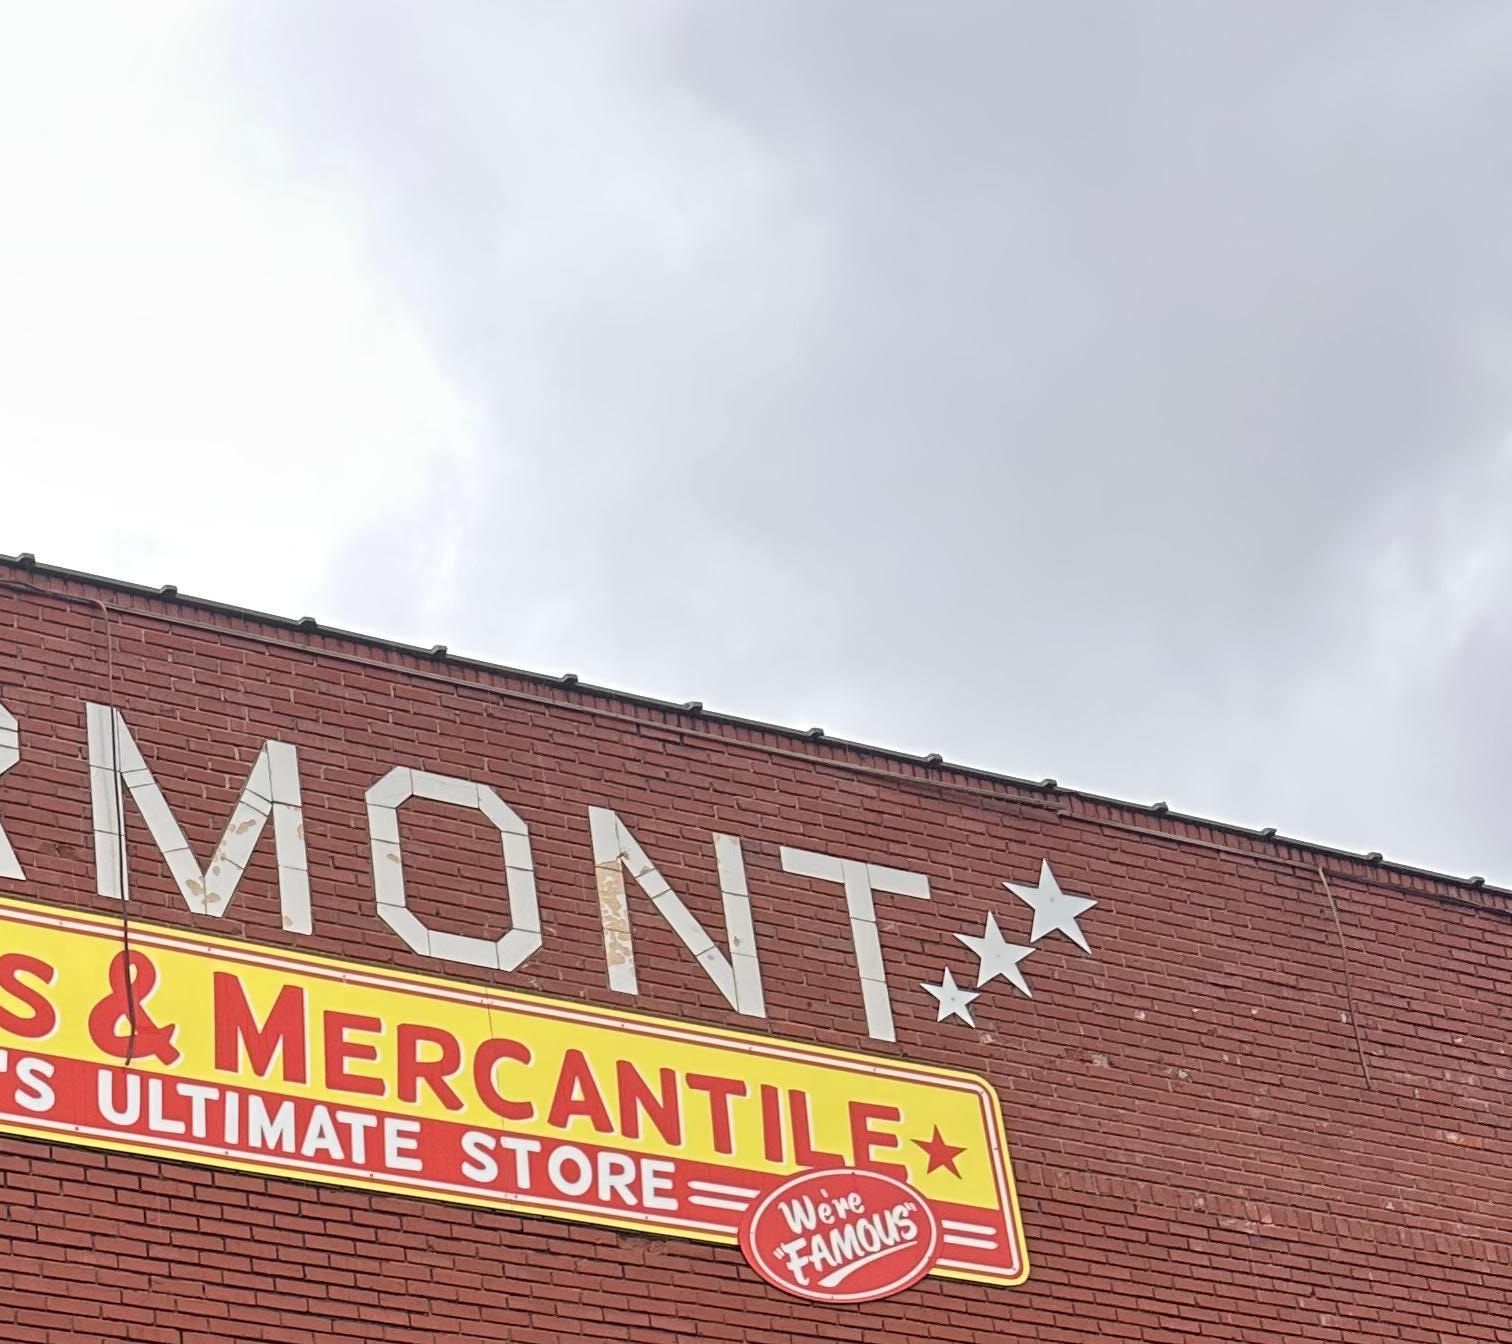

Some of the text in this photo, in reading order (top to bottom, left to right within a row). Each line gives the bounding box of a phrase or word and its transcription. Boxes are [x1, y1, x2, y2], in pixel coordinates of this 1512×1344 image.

[88, 950, 179, 1066] &
[214, 972, 909, 1184] MERCANTILE
[97, 1069, 423, 1171] ULTIMATE
[461, 1134, 678, 1212] STORE
[779, 1191, 865, 1238] We're
